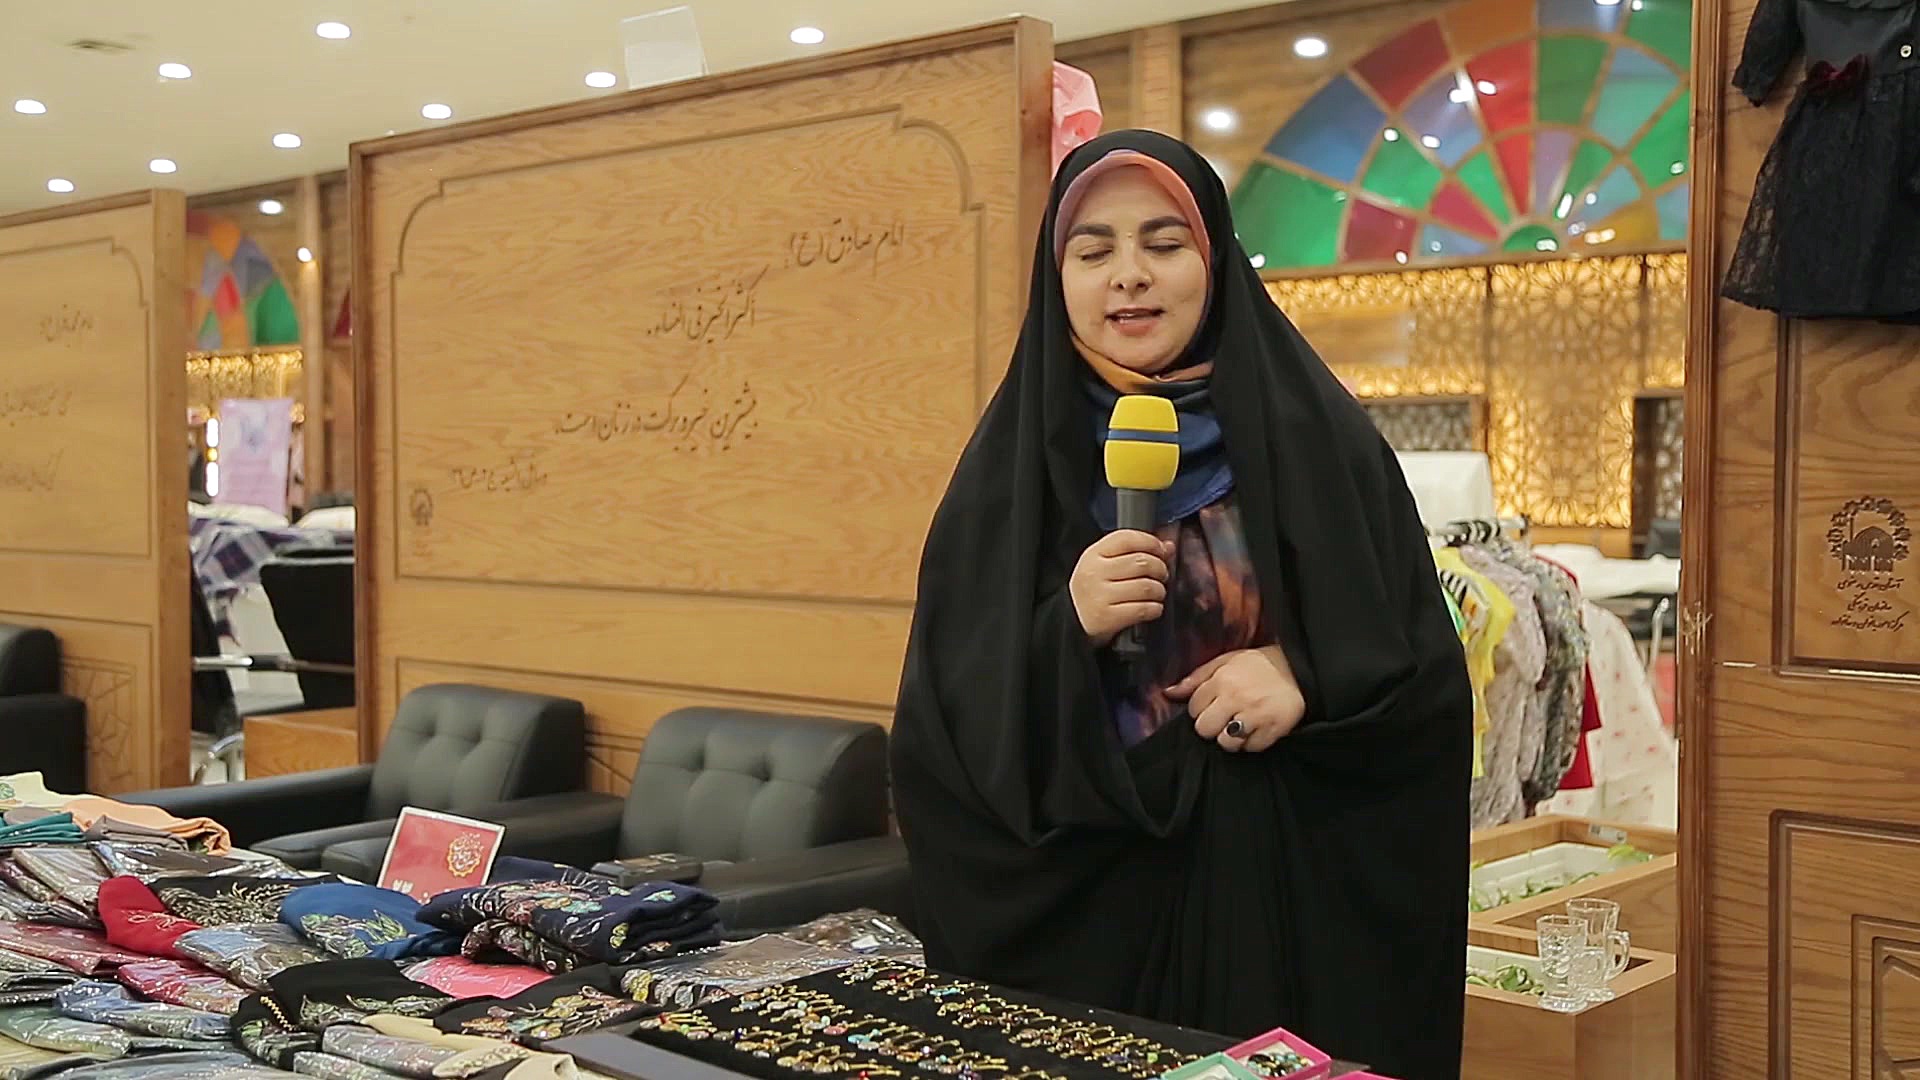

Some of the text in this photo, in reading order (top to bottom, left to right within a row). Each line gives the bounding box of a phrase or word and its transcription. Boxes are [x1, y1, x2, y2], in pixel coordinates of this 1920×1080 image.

[826, 218, 872, 264] صادق
[872, 223, 904, 279] امام
[598, 402, 631, 442] زنان
[644, 374, 689, 451] برکت
[682, 388, 710, 451] خیر
[710, 381, 759, 451] بیشترین
[1889, 610, 1911, 632] مرکز
